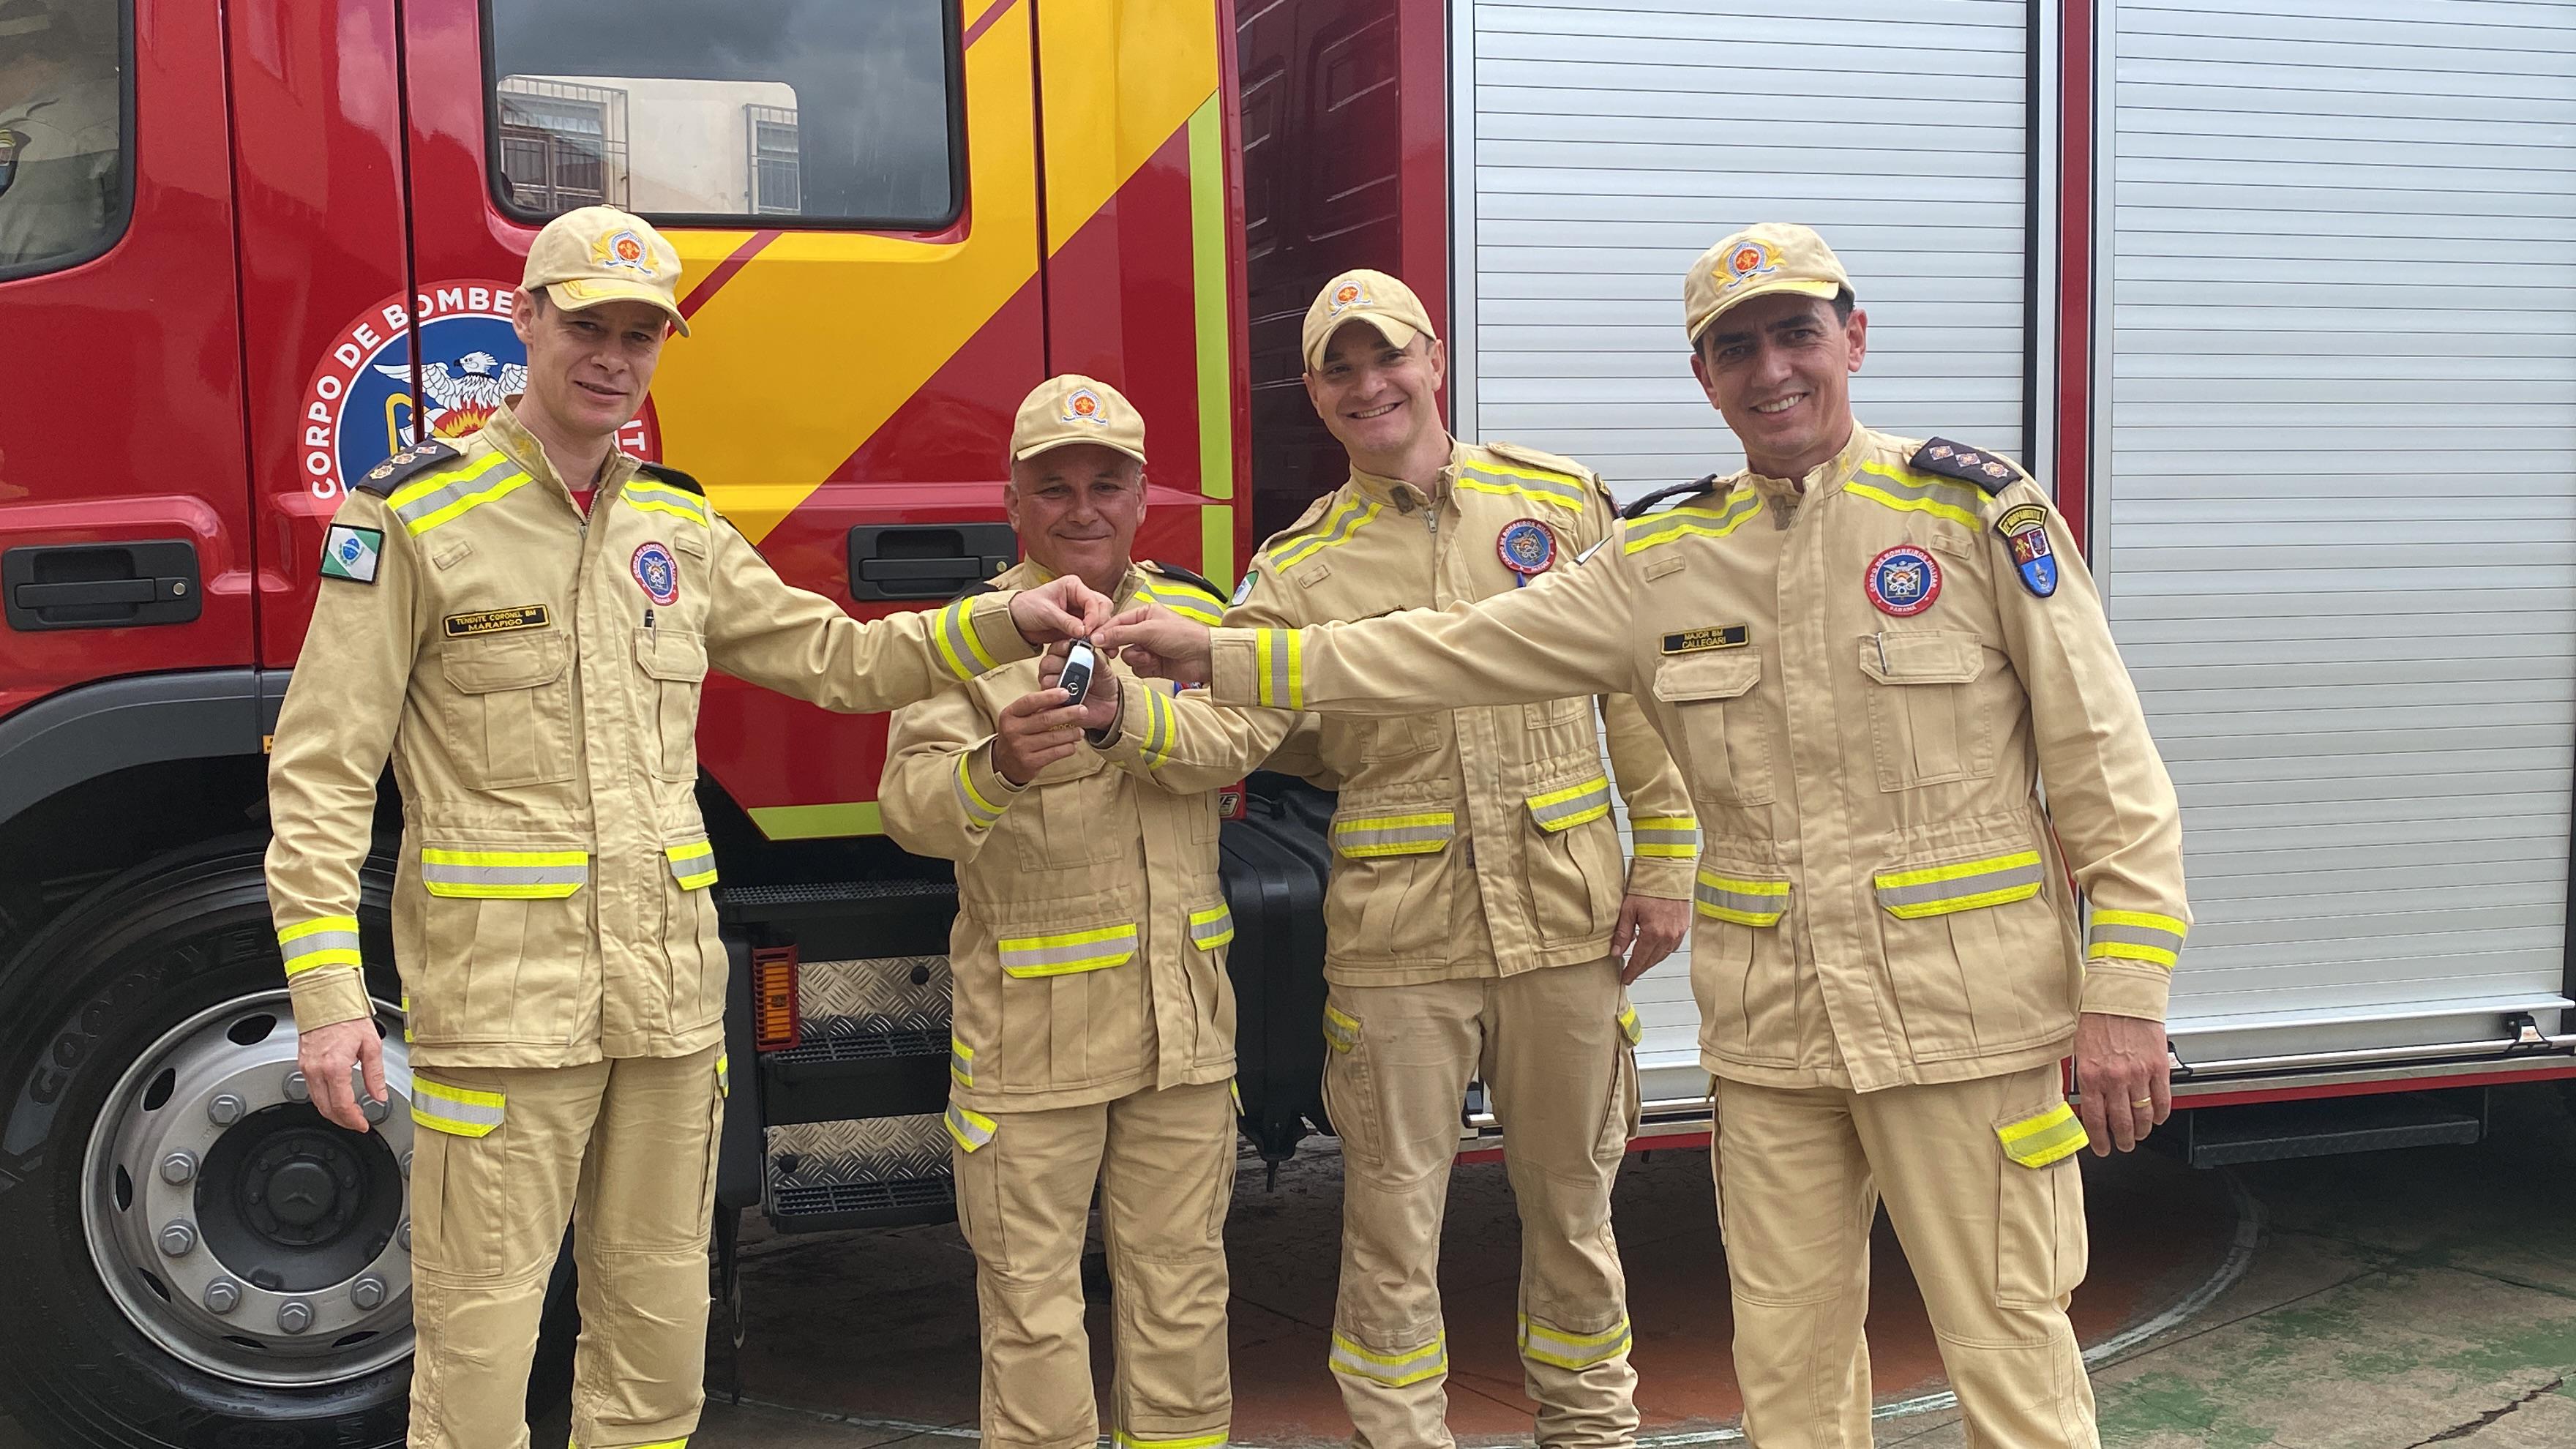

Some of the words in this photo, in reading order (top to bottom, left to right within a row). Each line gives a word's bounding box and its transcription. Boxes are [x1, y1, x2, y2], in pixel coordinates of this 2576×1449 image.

[305, 375, 342, 499] CORPO
[334, 322, 381, 370] DE
[382, 287, 513, 331] BOMBE
[1884, 549, 1928, 560] BOMBEIROS
[455, 615, 487, 625] TENENTE
[490, 612, 523, 621] CORONEL
[468, 619, 523, 631] MARAFIGO
[1684, 632, 1710, 640] MAJOR
[1682, 636, 1726, 649] CALLEGARI
